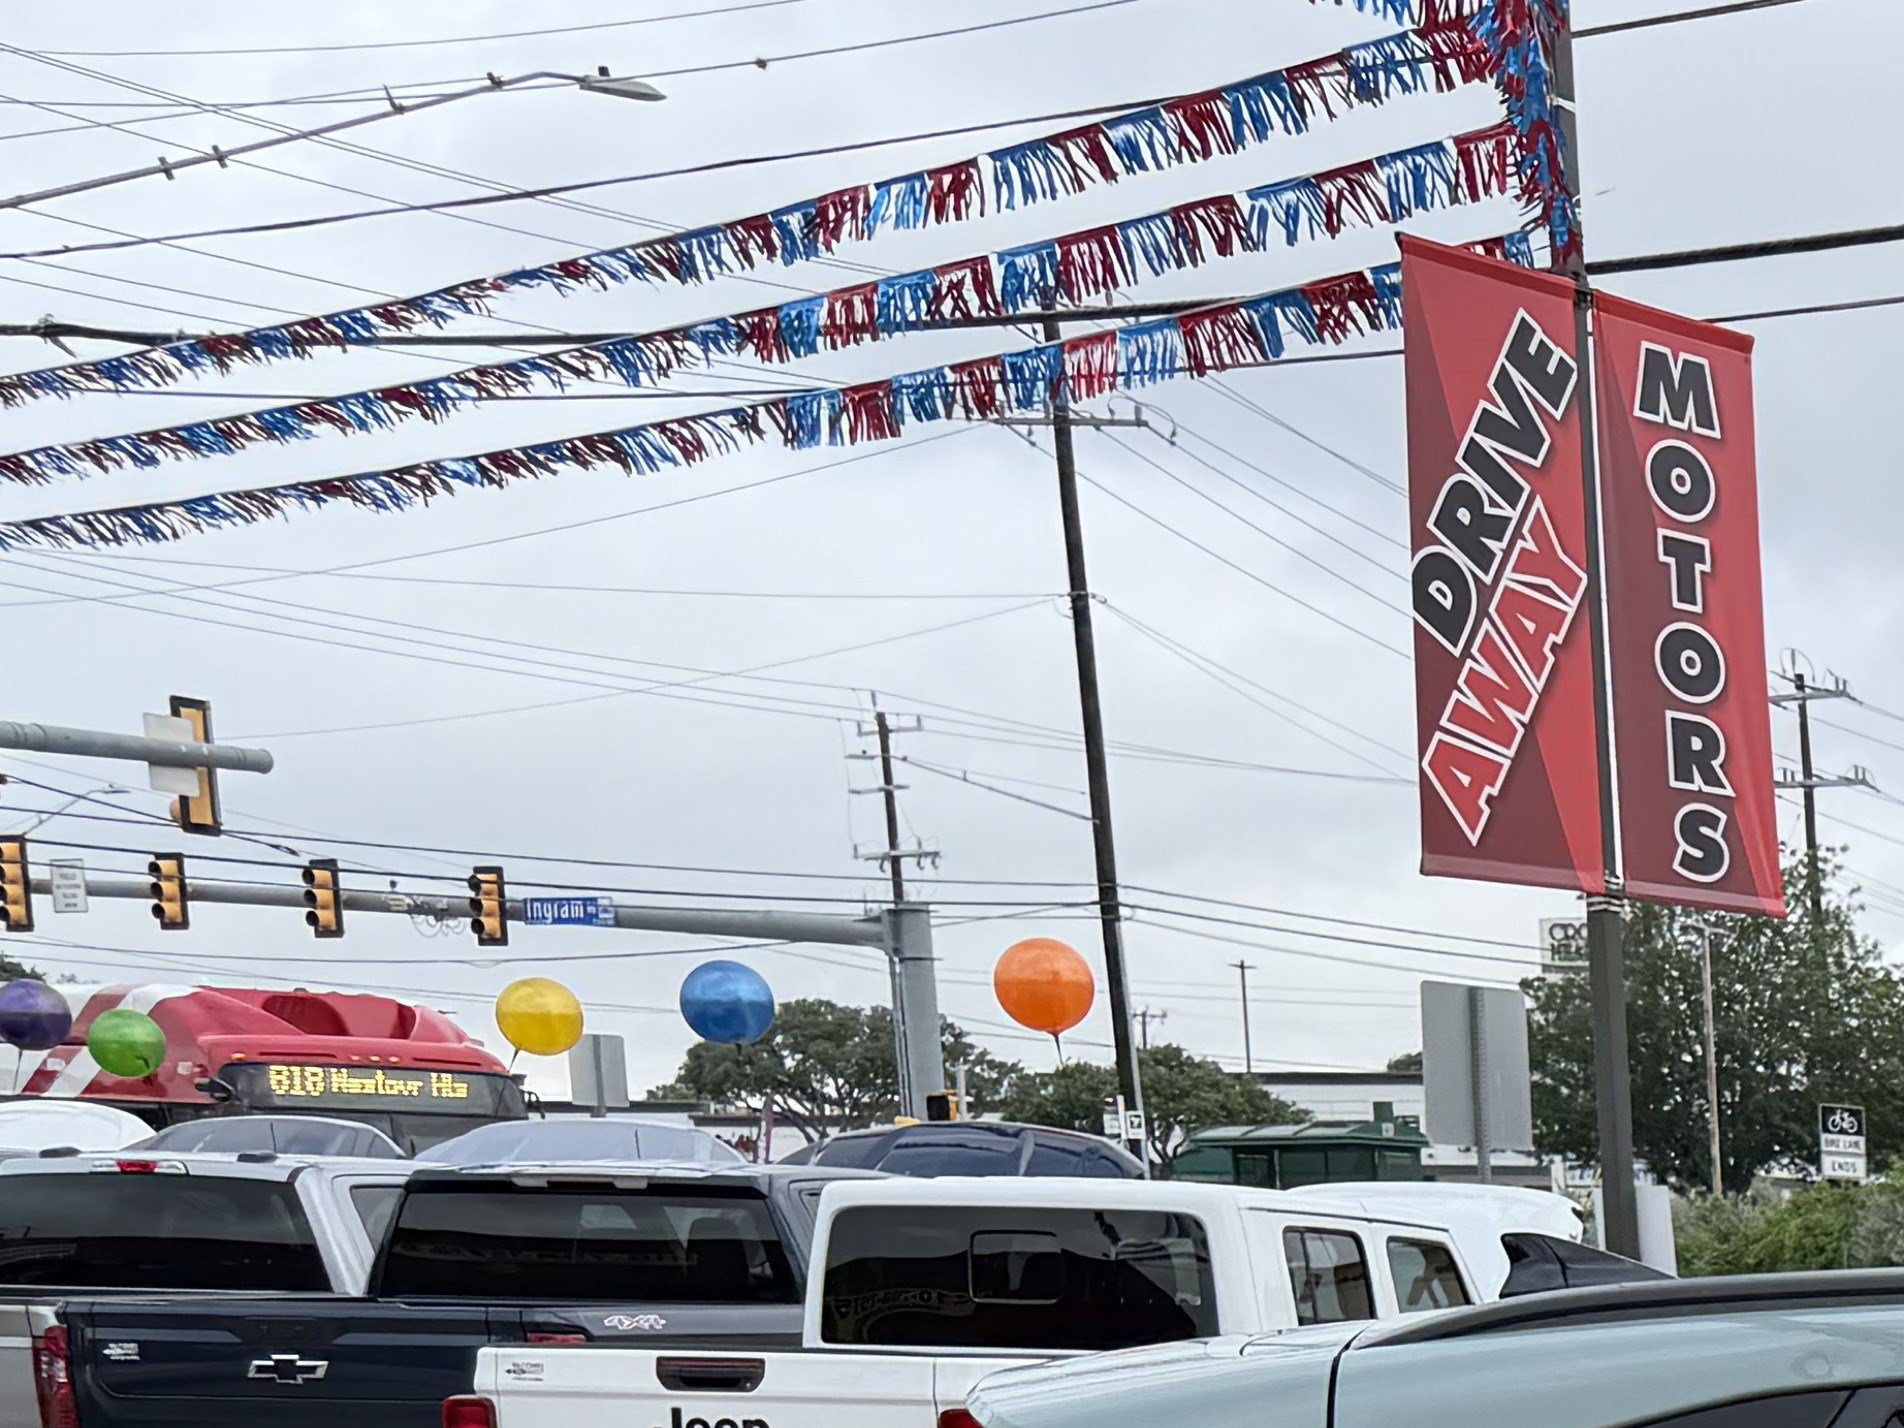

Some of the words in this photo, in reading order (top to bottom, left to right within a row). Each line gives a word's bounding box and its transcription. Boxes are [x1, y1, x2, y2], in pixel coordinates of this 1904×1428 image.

[1411, 307, 1578, 657] DRIVE
[1633, 340, 1736, 883] MOTORS
[1421, 495, 1588, 847] AWAY
[527, 898, 584, 924] Ingram
